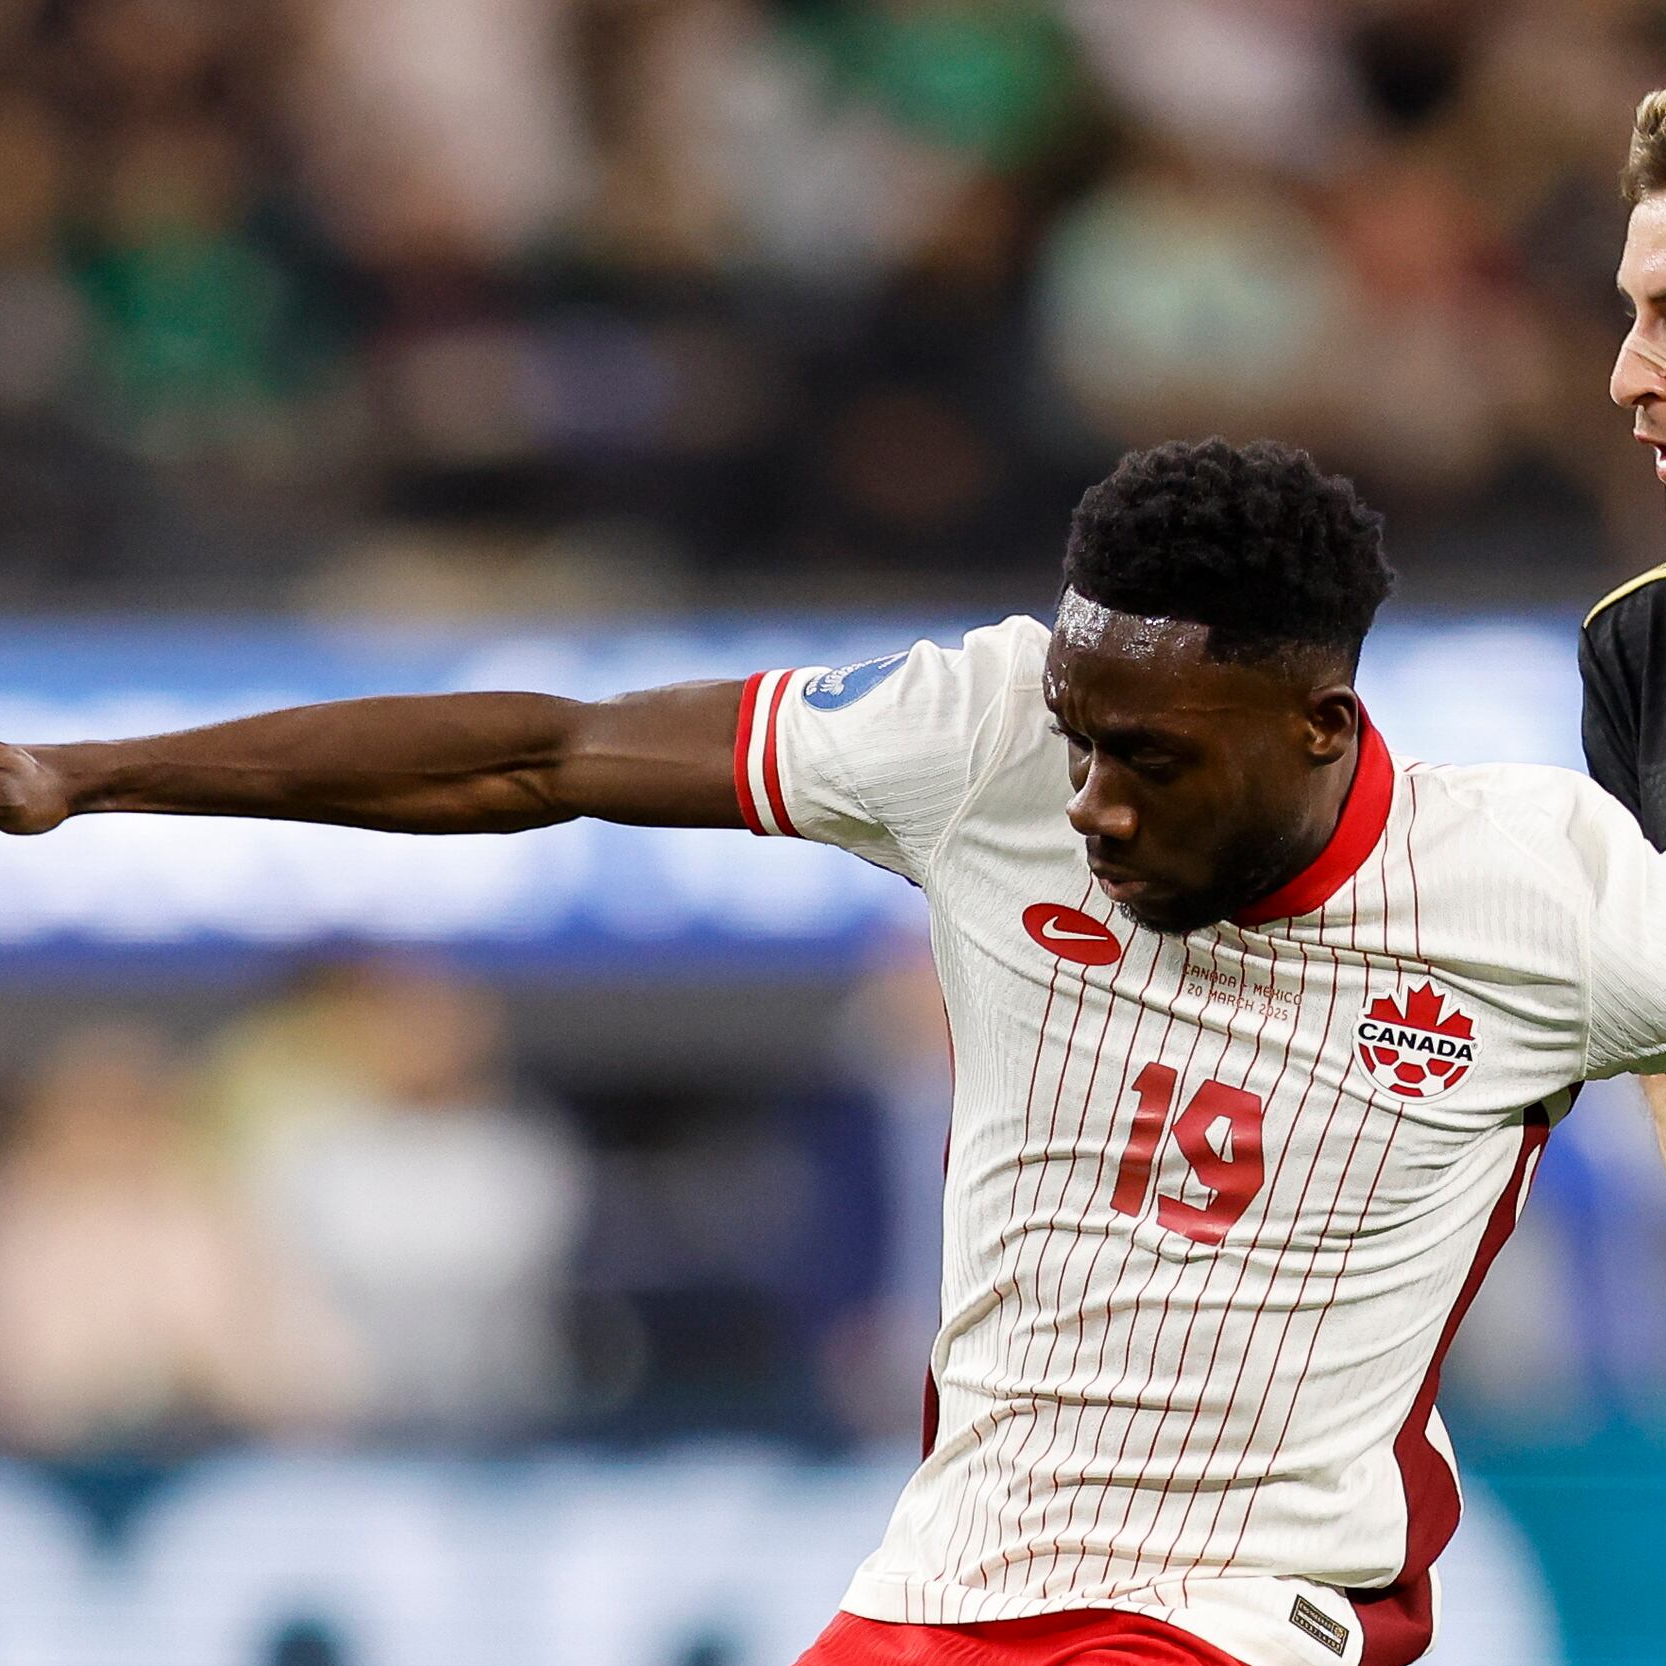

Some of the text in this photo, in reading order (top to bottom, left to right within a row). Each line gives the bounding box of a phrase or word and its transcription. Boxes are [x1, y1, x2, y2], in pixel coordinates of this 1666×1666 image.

[1184, 963, 1237, 988] CANADA
[1253, 983, 1302, 1006] MEXICO
[1187, 983, 1288, 1021] 20 MARCH 2025
[1358, 1022, 1473, 1062] CANADA
[1110, 1061, 1264, 1246] 19
